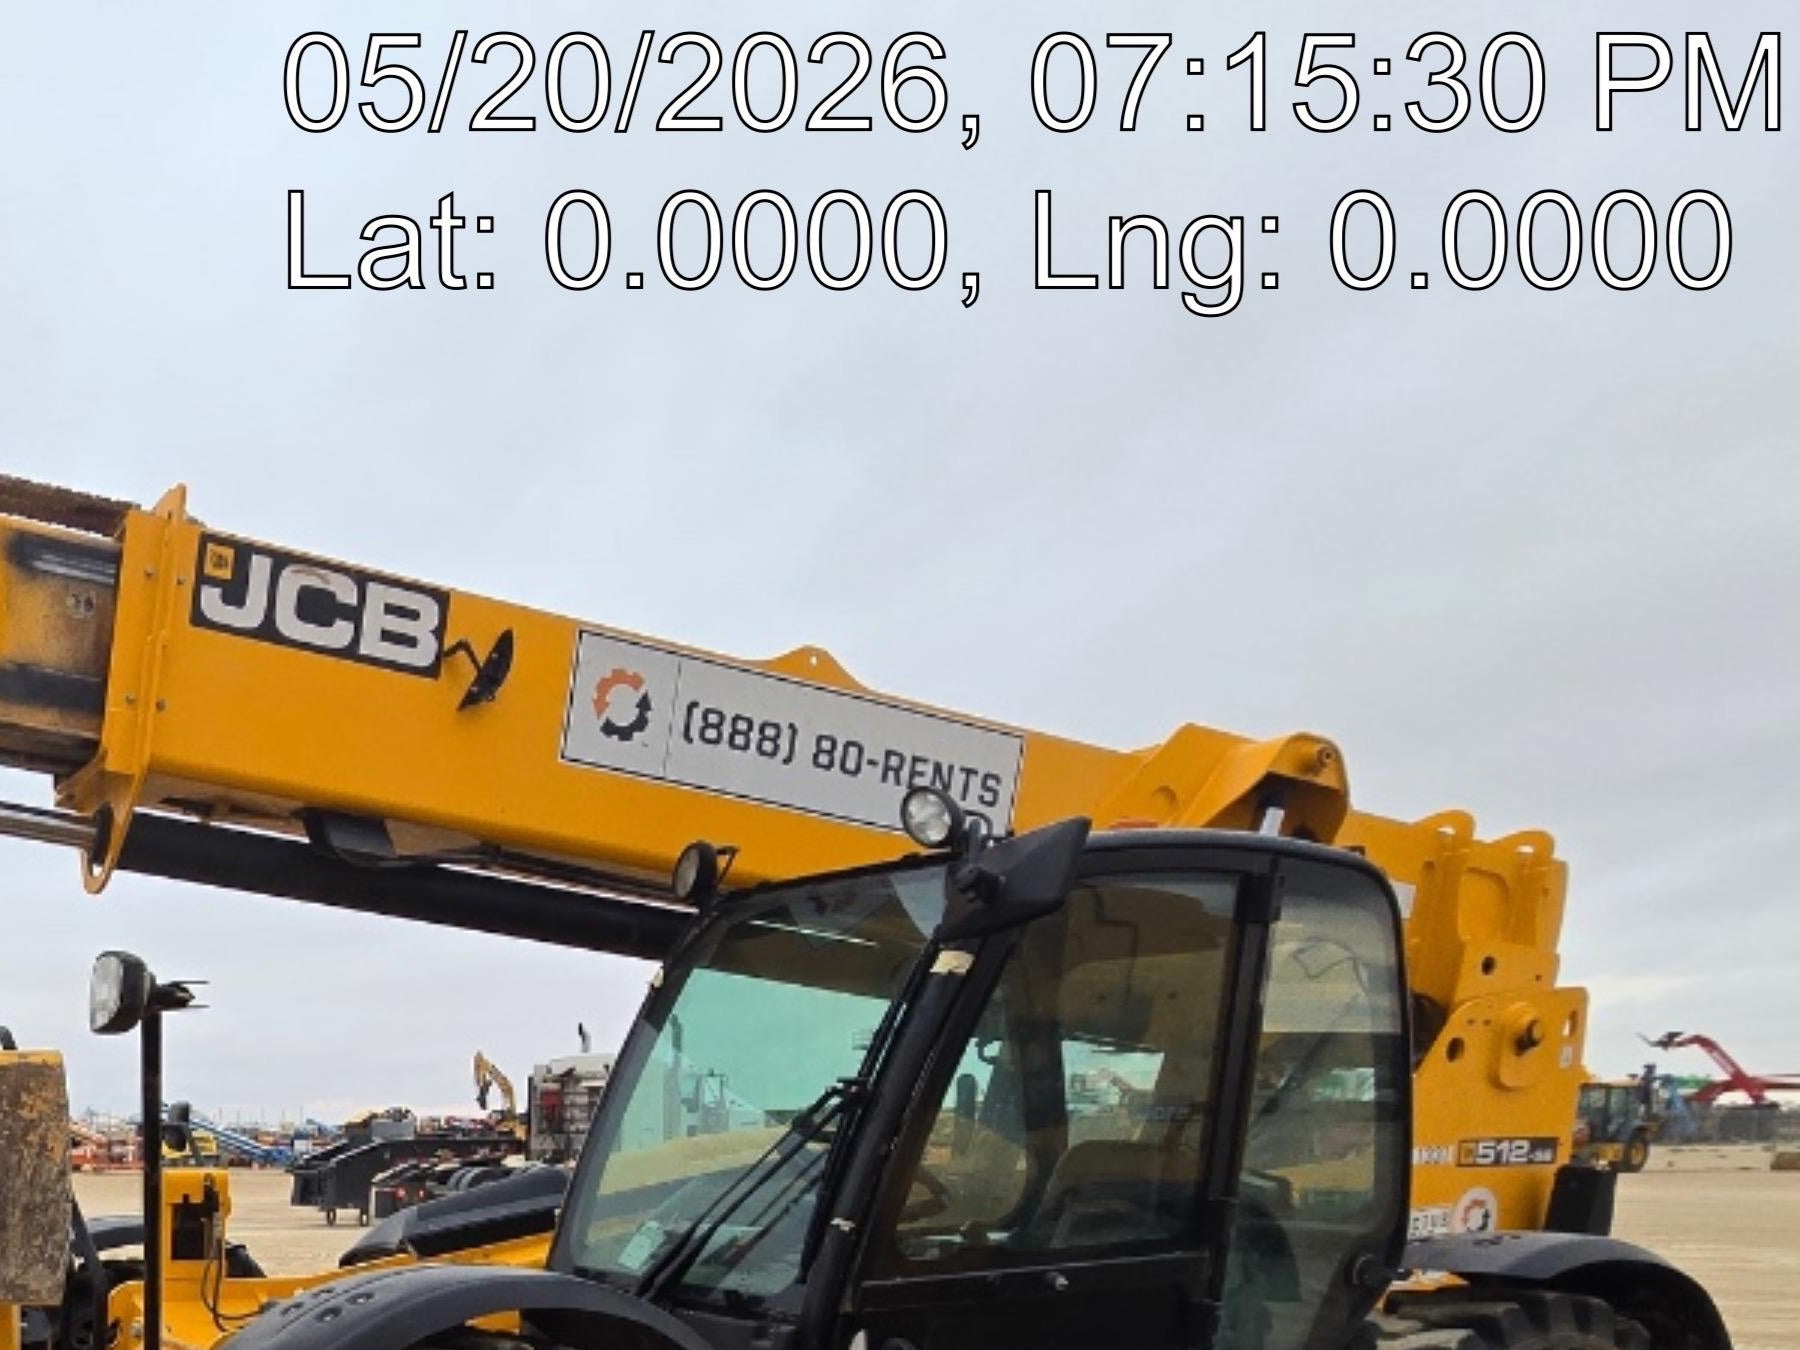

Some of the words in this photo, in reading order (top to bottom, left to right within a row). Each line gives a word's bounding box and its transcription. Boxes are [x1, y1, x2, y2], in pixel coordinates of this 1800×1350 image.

[201, 553, 440, 668] JCB
[682, 701, 799, 765] (888)
[812, 734, 1002, 807] 80-RENTS
